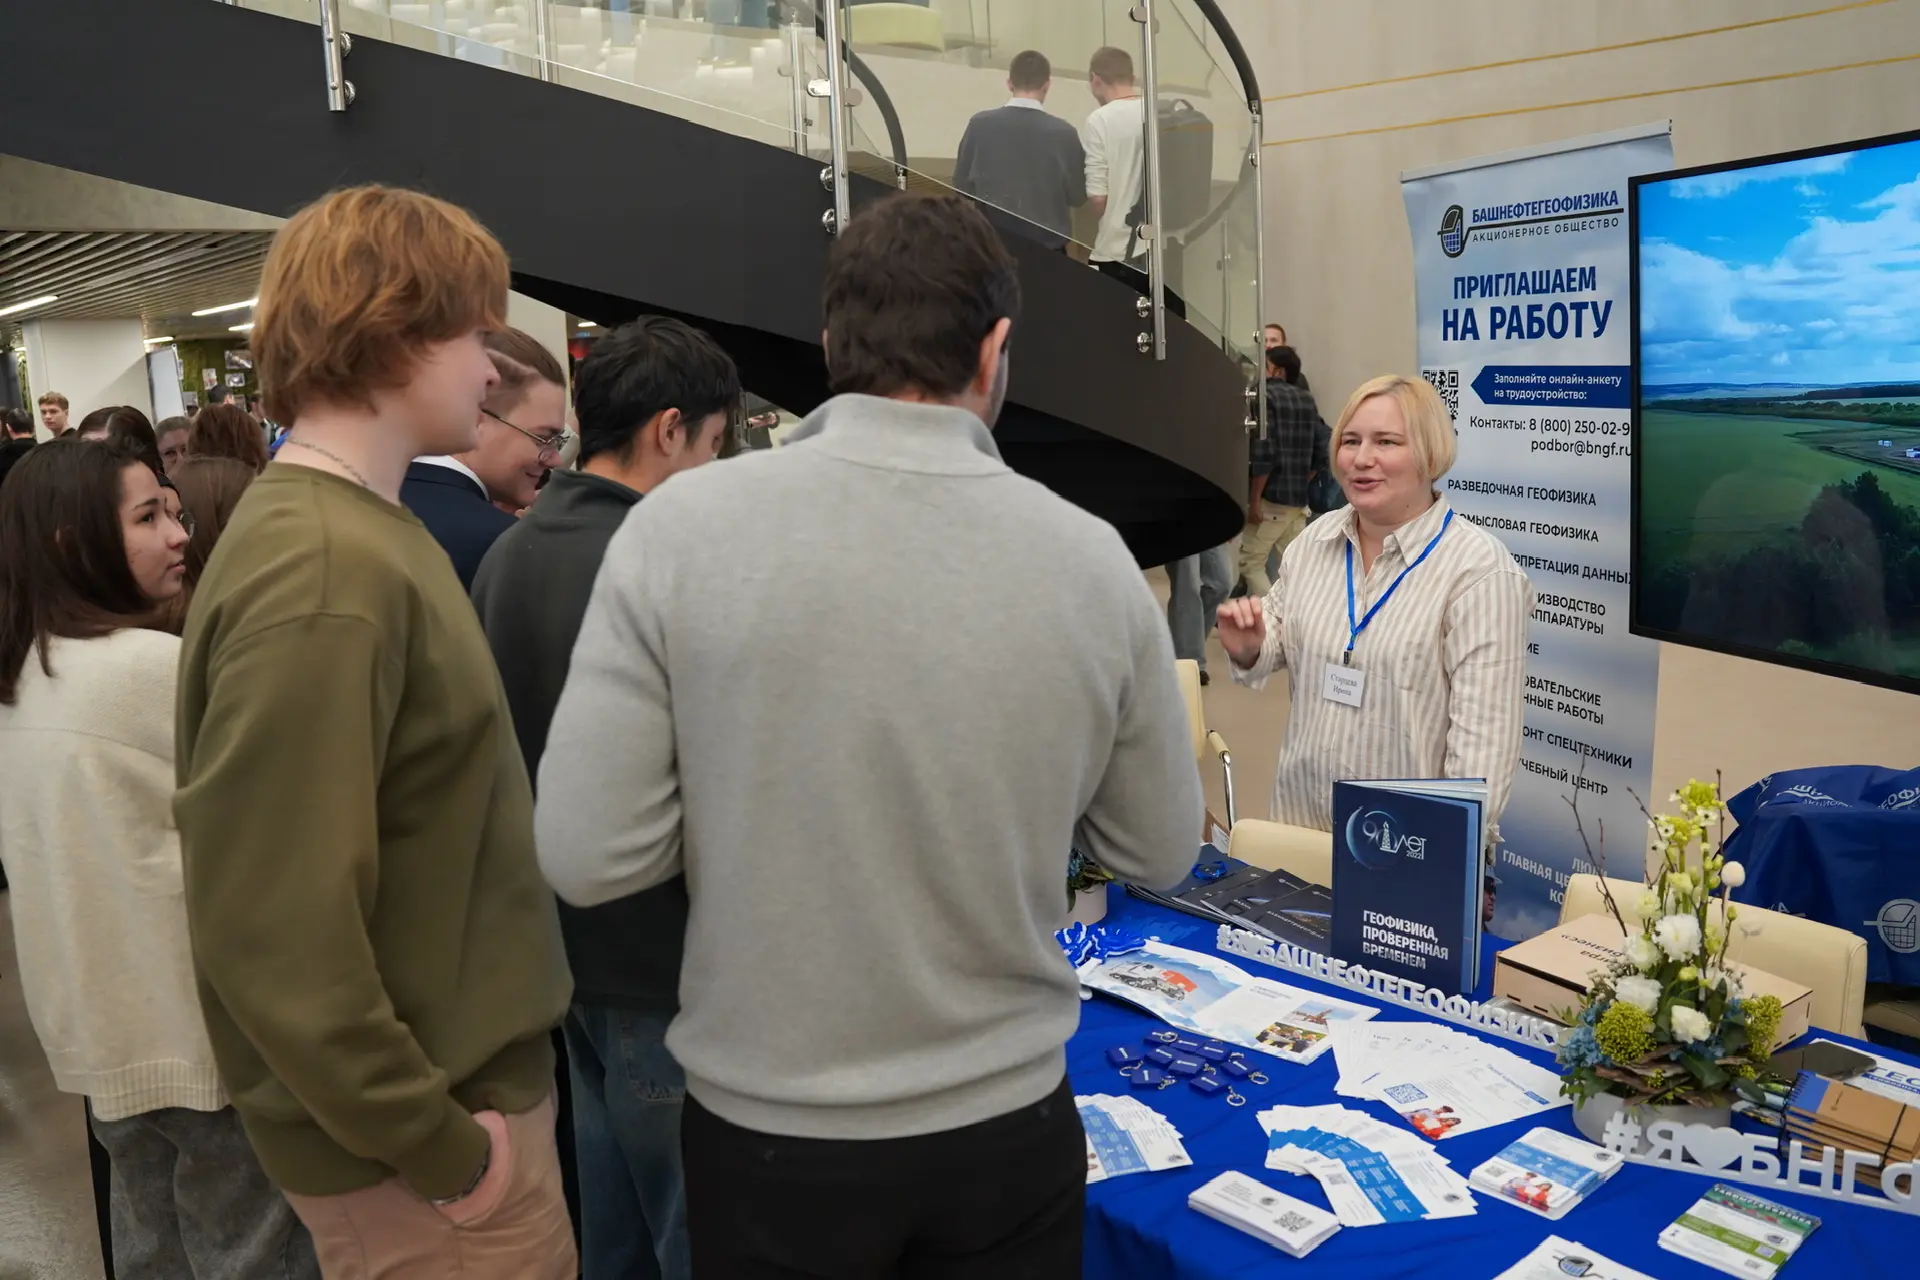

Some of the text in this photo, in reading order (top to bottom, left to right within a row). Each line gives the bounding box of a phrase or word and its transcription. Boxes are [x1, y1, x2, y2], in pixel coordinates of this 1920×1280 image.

[1472, 190, 1618, 223] БАШНЕФТЕГЕОФИЗИКА
[1472, 217, 1620, 243] АКЦИОНЕРНОЕ ОБЩЕСТВО
[1453, 266, 1597, 300] ПРИГЛАШАЕМ
[1442, 300, 1613, 342] НА РАБОТУ
[1494, 373, 1622, 388] Заполняйте онлайн-анкету
[1494, 388, 1588, 401] на трудоустройство:
[1470, 416, 1526, 431] Контакты:
[1529, 418, 1537, 431] 8
[1540, 419, 1572, 436] (800)
[1531, 438, 1632, 458] podbor@bngf.ru
[1448, 479, 1597, 506] РАЗВЕДОЧНАЯ ГЕОФИЗИКА
[1529, 522, 1600, 542] ГЕОФИЗИКА
[1511, 553, 1579, 576] РПРЕТАЦИЯ
[1557, 701, 1604, 725] РАБОТЫ
[1547, 733, 1632, 769] СПЕЦТЕХНИКИ
[1519, 757, 1608, 796] ЧЕБНЫЙ ЦЕНТР
[1503, 849, 1552, 881] ГЛАВНАЯ
[1363, 909, 1438, 944] ГЕОФИЗИКА,
[1362, 925, 1448, 961] ПРОВЕРЕННАЯ
[1362, 941, 1426, 970] ВРЕМЕНЕМ
